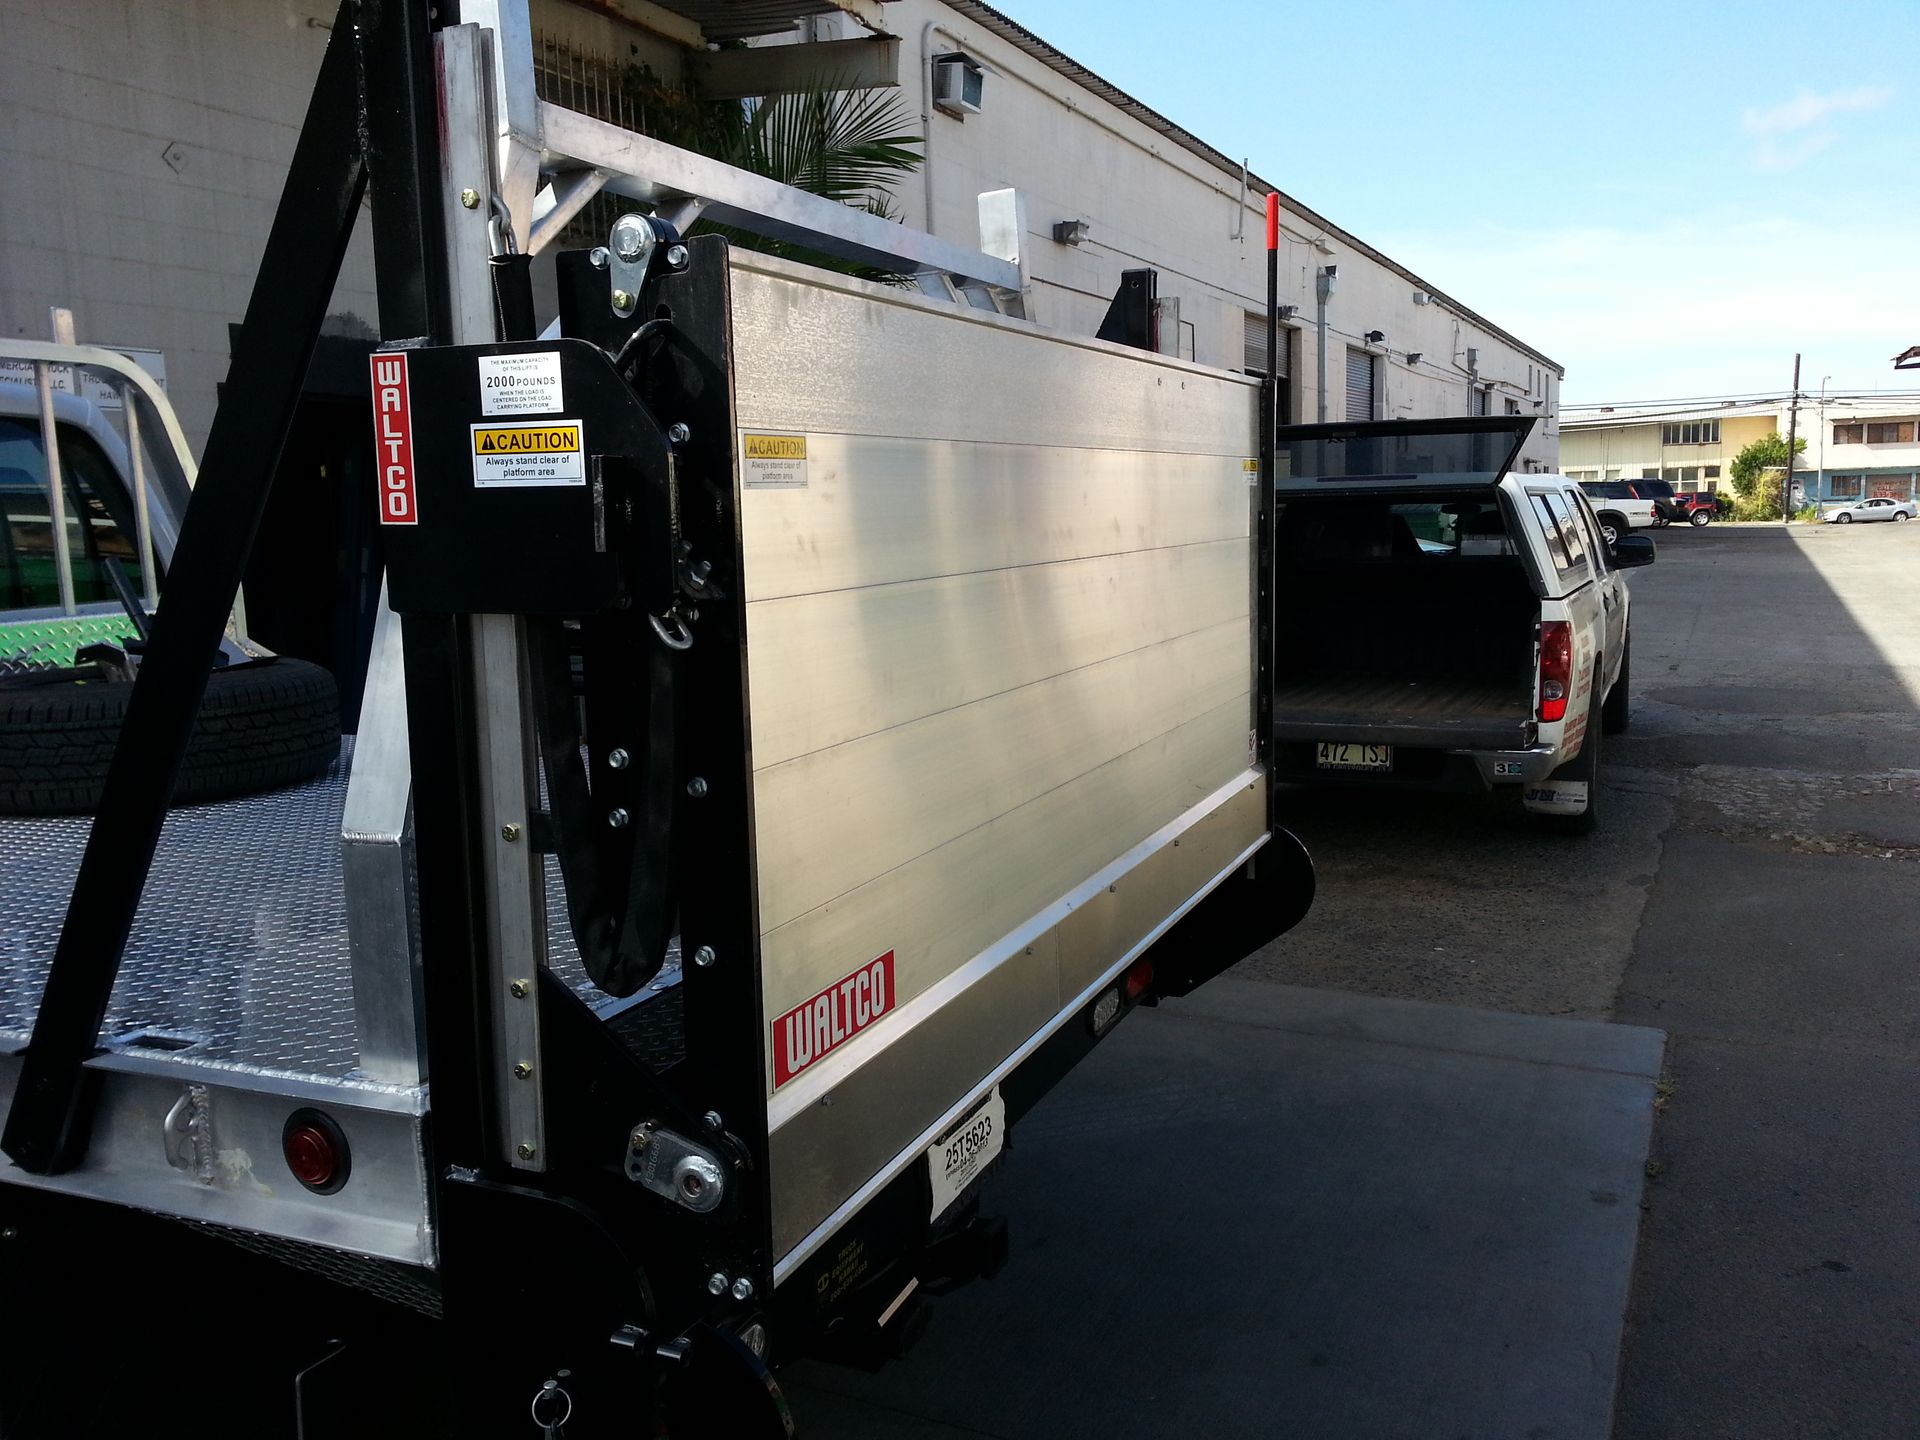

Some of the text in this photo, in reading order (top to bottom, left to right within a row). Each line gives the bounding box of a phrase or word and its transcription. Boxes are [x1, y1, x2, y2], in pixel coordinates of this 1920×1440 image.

[486, 375, 556, 388] 2000 POUNDS
[377, 361, 408, 516] WALTCO
[497, 431, 575, 450] CAUTION
[758, 440, 804, 456] CAUTION
[486, 455, 570, 467] Always stand clear of
[503, 468, 536, 478] platform
[786, 961, 885, 1074] WALTCO
[946, 1116, 992, 1171] 25T5623
